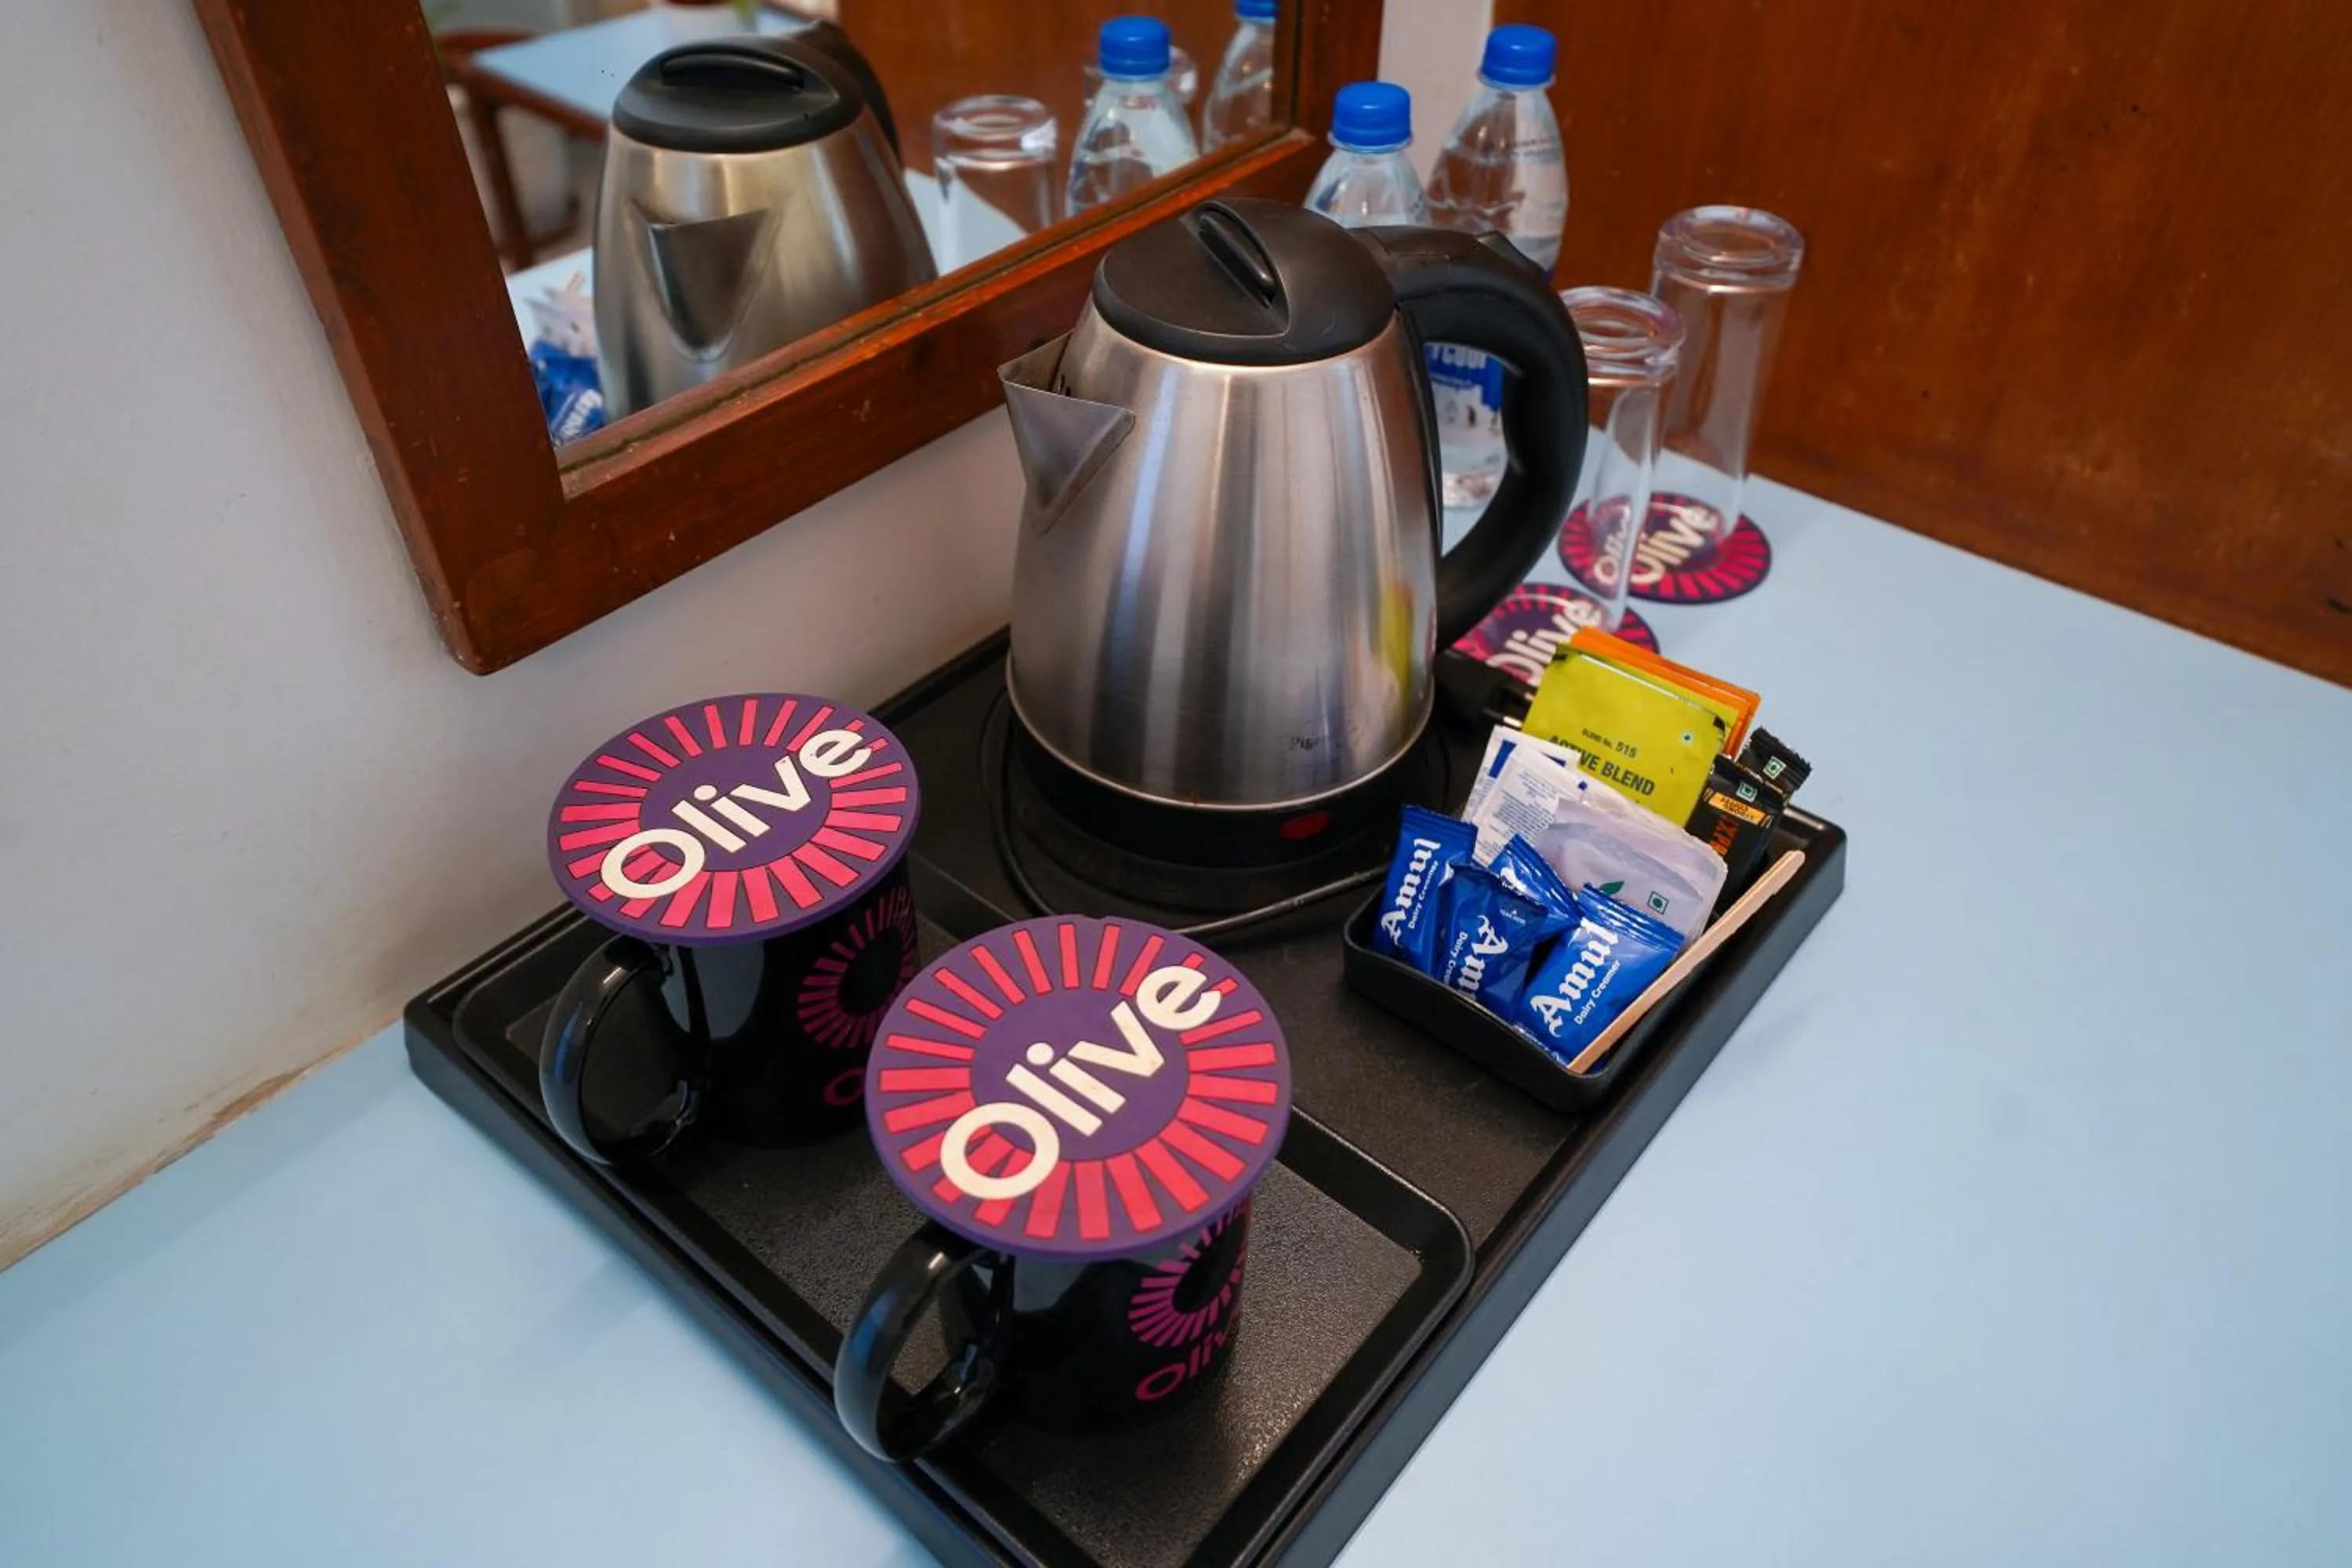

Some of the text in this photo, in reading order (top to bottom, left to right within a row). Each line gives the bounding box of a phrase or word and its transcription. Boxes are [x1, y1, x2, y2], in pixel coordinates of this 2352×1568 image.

[1601, 760, 1656, 796] BLEND
[1615, 740, 1637, 758] 515
[601, 729, 872, 899] Olive
[1381, 838, 1442, 948] Amul
[1408, 859, 1439, 930] Dairy Creamer
[1450, 930, 1468, 959] Dairy
[1457, 914, 1509, 998] Am
[1530, 916, 1619, 1038] Amul
[1573, 959, 1621, 1025] Dairy Creamer
[941, 965, 1222, 1200] Olive
